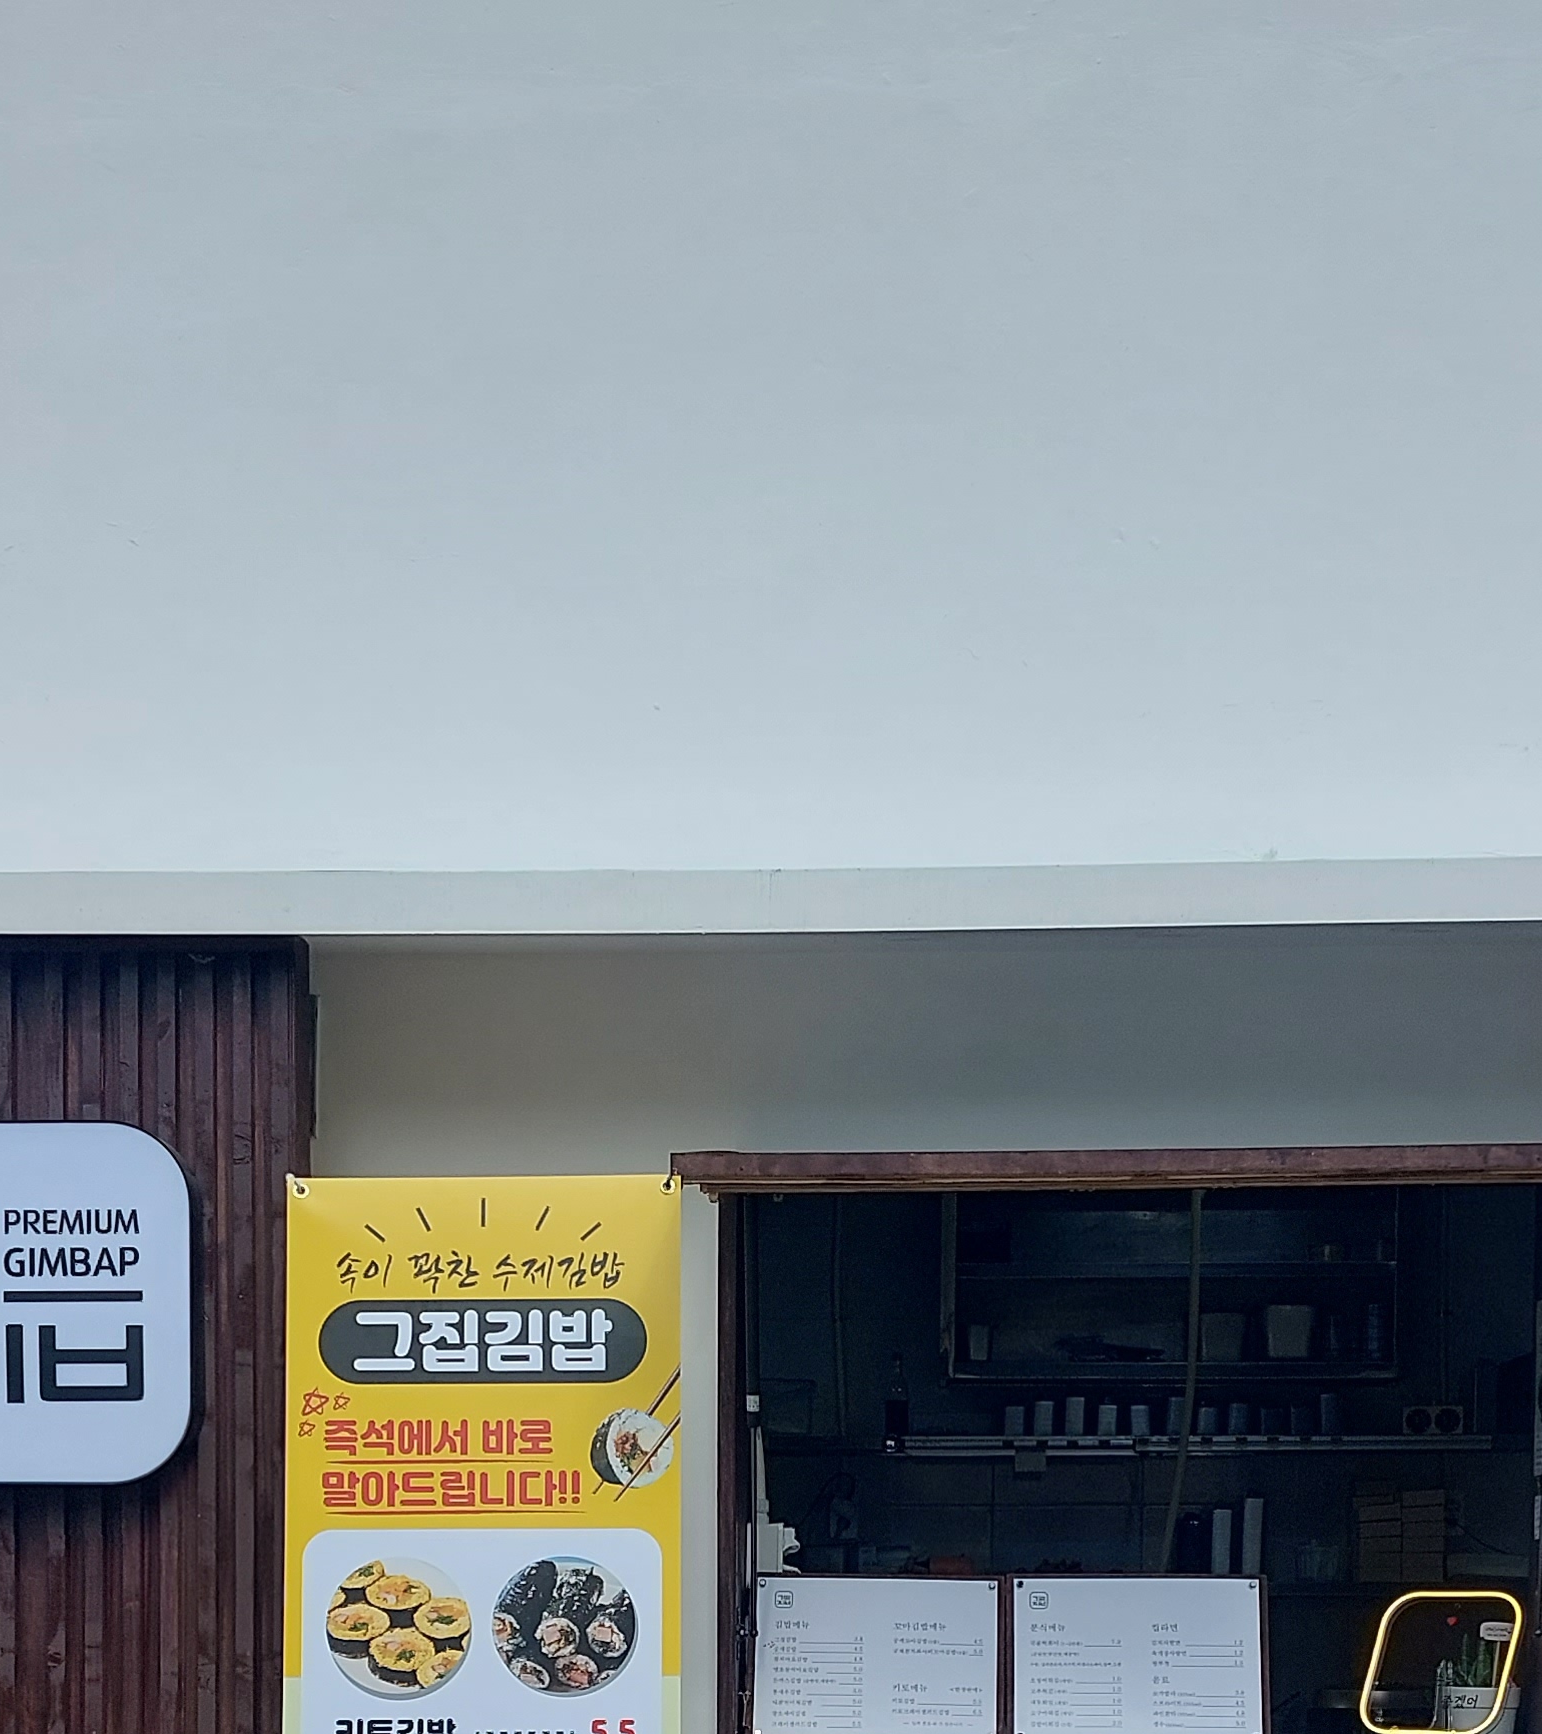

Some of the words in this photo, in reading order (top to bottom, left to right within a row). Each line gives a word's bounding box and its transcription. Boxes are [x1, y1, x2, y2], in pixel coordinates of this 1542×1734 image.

[3, 1209, 140, 1235] PREMIUM
[3, 1246, 140, 1278] GIMBAP
[337, 1251, 394, 1294] 속이
[492, 1251, 626, 1292] 수제김밥
[353, 1308, 613, 1372] 그집김밥
[323, 1419, 469, 1456] 즉석에서
[481, 1418, 553, 1455] 바로
[321, 1470, 581, 1508] 말아드립니다!!
